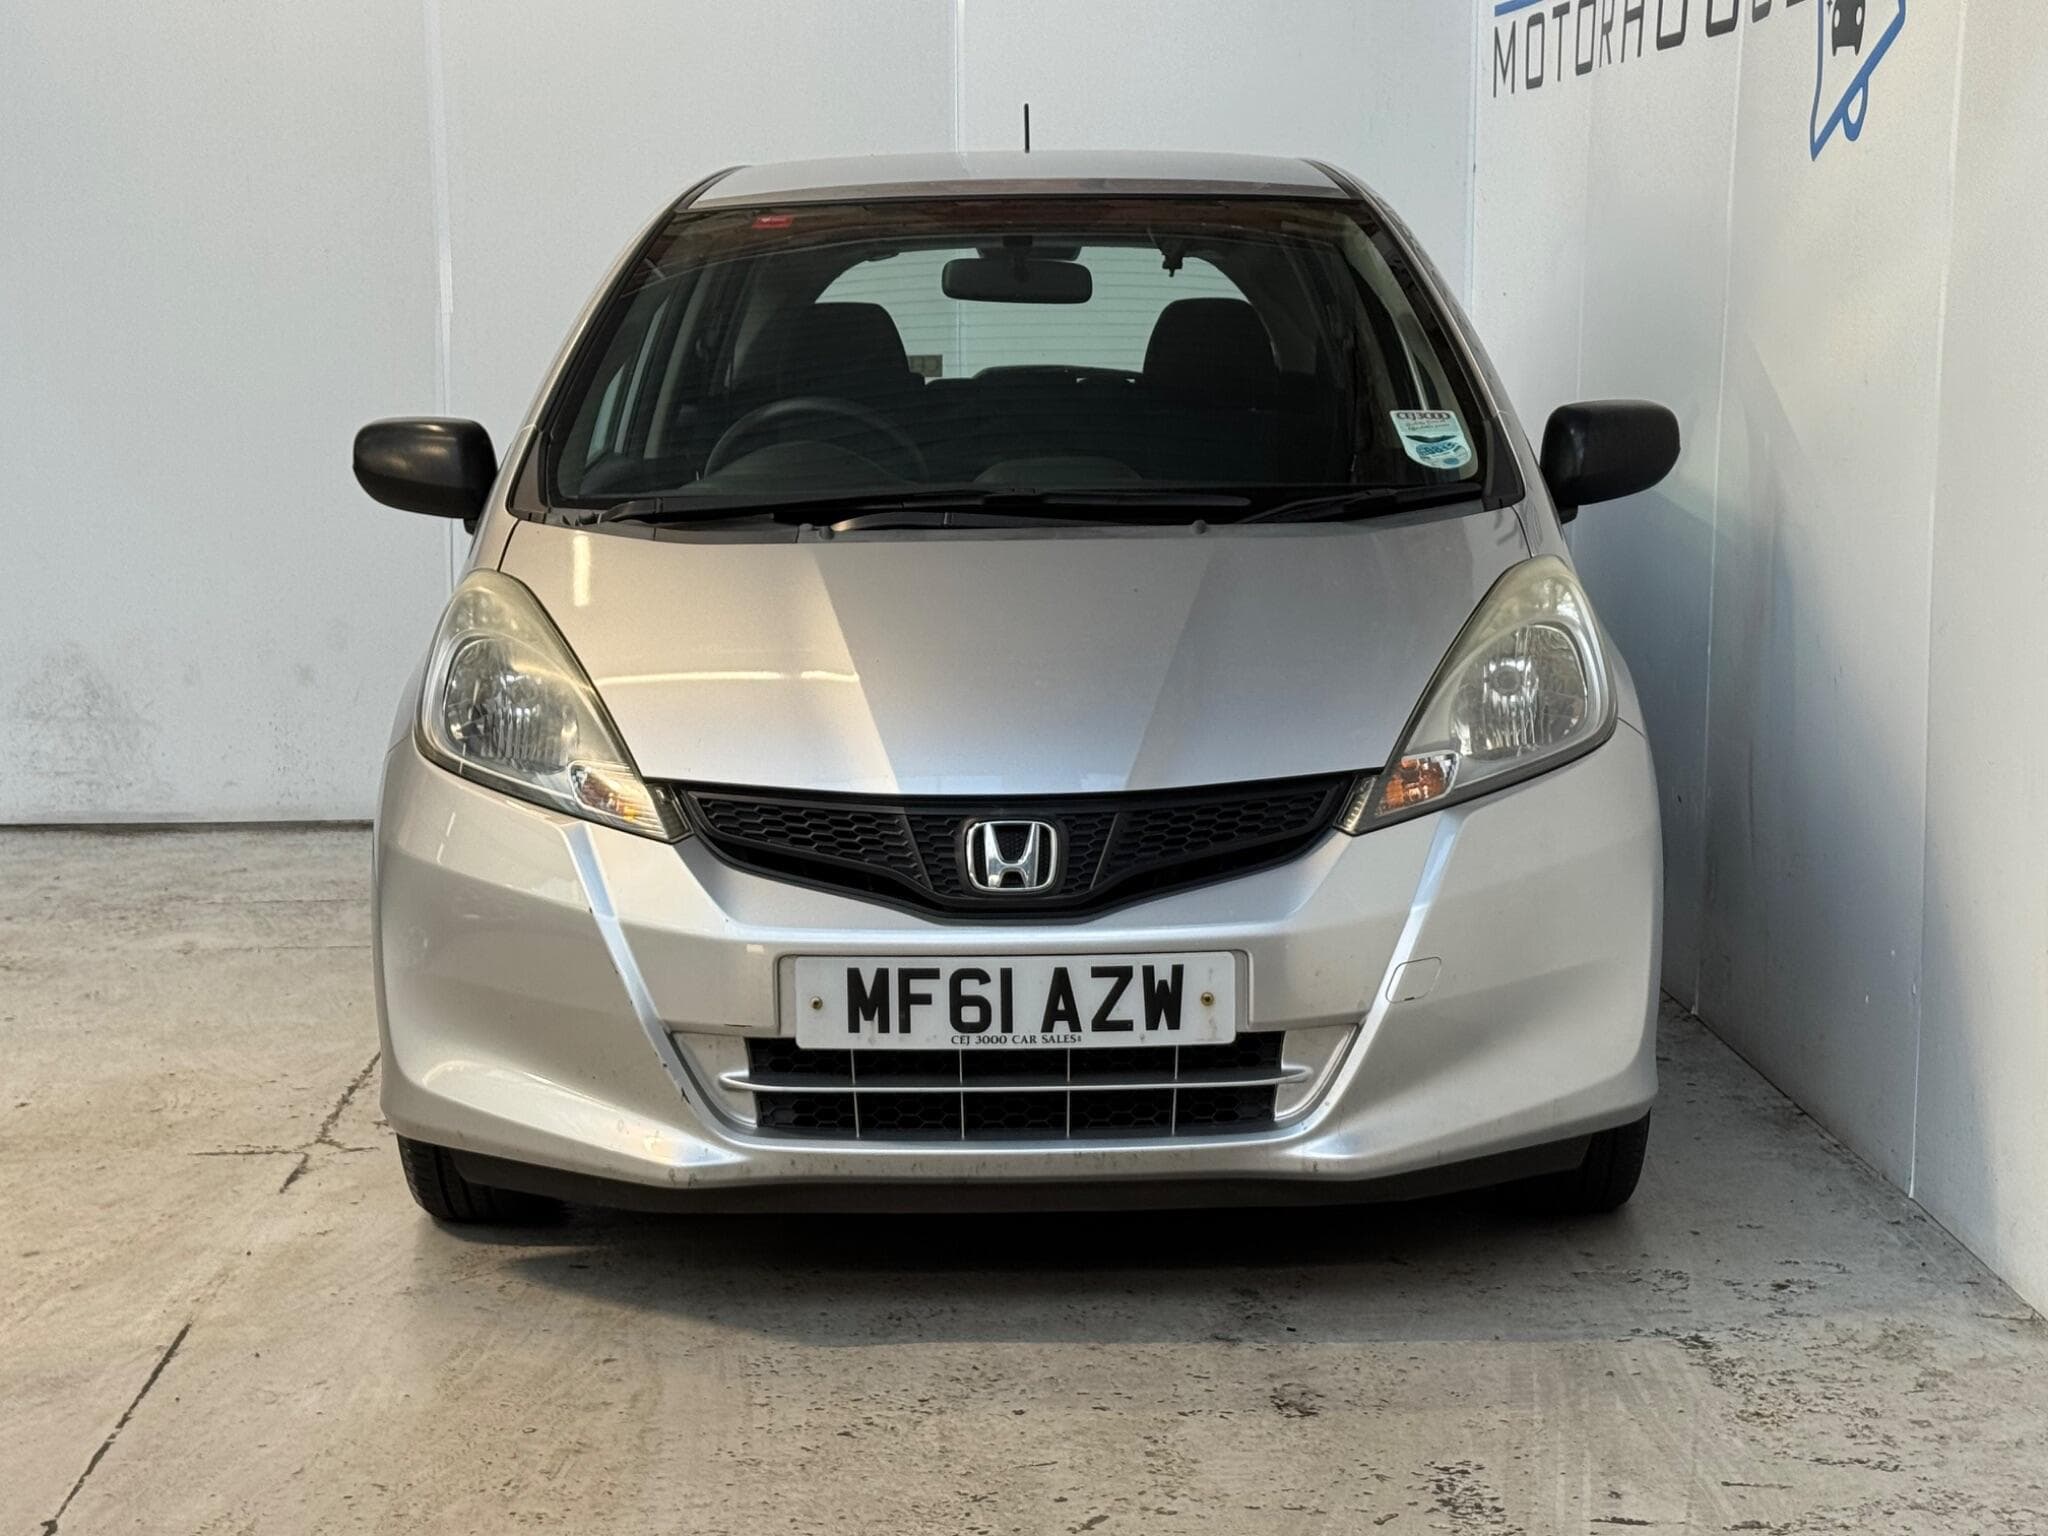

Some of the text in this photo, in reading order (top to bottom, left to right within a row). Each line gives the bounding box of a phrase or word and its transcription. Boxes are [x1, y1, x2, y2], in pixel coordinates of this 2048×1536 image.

[1494, 0, 1803, 97] MOTORHO
[846, 964, 1185, 1034] MF61 AZW
[974, 1035, 1008, 1045] 3000
[1011, 1035, 1038, 1045] CAR
[1041, 1034, 1077, 1045] SALES
